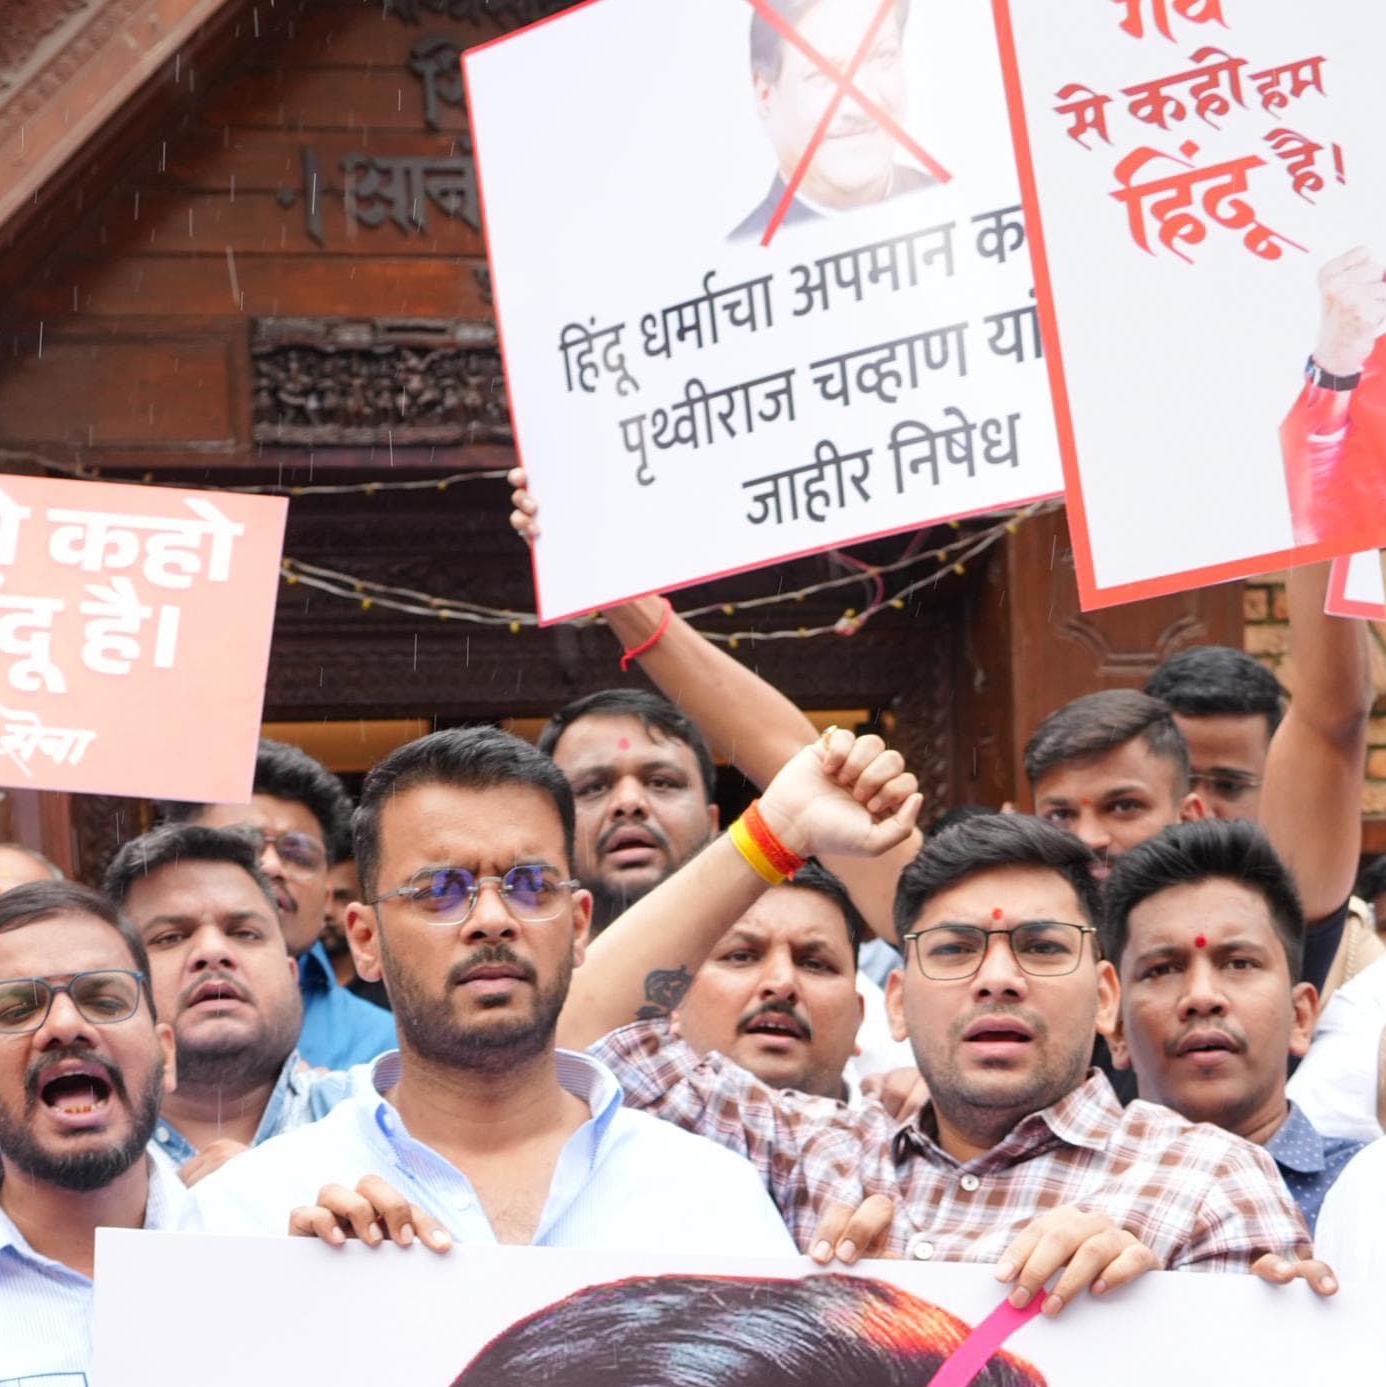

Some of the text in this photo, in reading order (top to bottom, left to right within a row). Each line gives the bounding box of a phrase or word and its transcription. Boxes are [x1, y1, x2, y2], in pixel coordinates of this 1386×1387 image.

[1053, 46, 1327, 151] से कहो हम
[1109, 139, 1310, 265] हिंदू
[559, 317, 640, 397] हिंदू
[639, 270, 774, 358] धर्माचा
[790, 221, 956, 317] अपमान
[618, 369, 797, 486] पृथ्वीराज
[809, 321, 969, 407] चव्हाण
[742, 406, 1022, 524] जाहीर निषेध
[47, 497, 245, 589] कहो
[79, 577, 181, 675] है।
